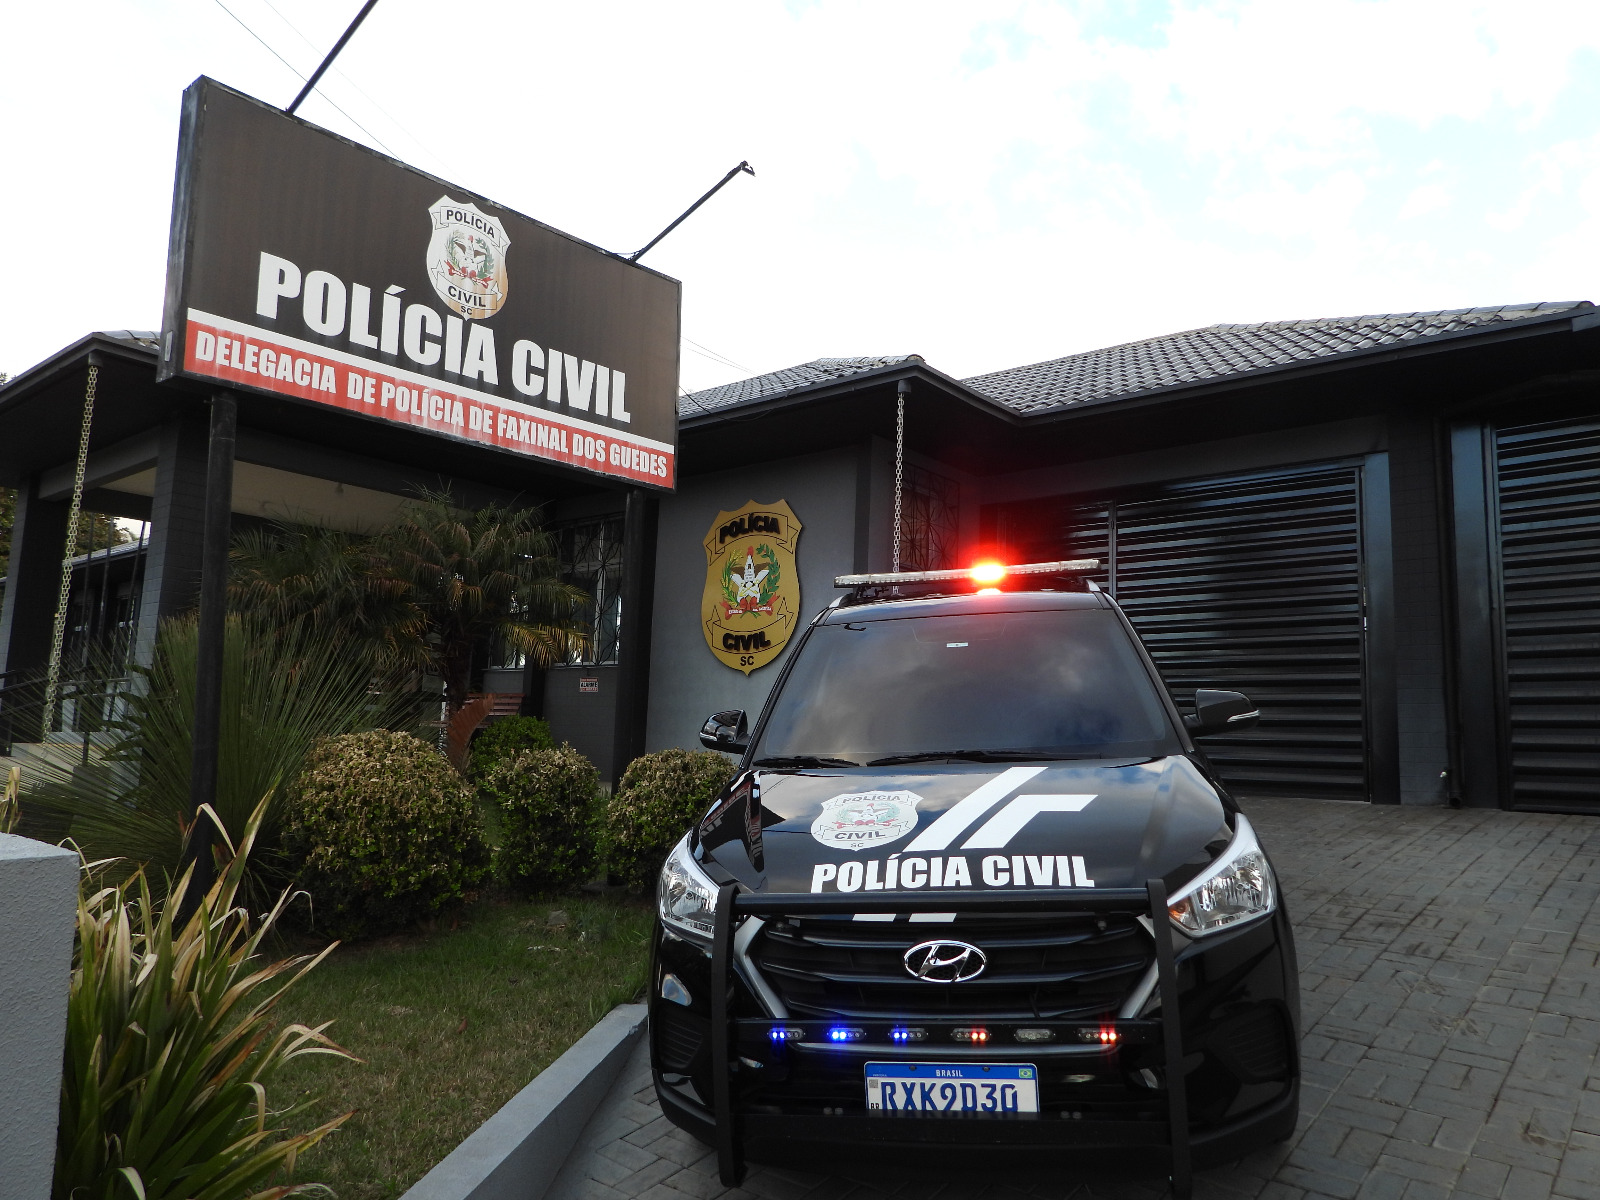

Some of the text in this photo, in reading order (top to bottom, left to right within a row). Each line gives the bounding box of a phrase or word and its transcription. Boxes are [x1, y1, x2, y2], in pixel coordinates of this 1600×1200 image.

[446, 209, 495, 239] POLÍCIA
[448, 285, 487, 308] CIVIL
[460, 305, 473, 315] SC
[256, 251, 631, 424] POLÍCIA CIVIL
[195, 330, 667, 477] DELEGACIA DE POLÍCIA DE FAXINAL DOS GUEDES
[719, 513, 781, 545] POLÍCIA
[722, 631, 771, 652] CIVIL
[740, 655, 755, 666] SC
[834, 831, 886, 840] CIVIL
[810, 853, 1095, 893] POLÍCIA CIVIL
[935, 1069, 963, 1077] BRASIL
